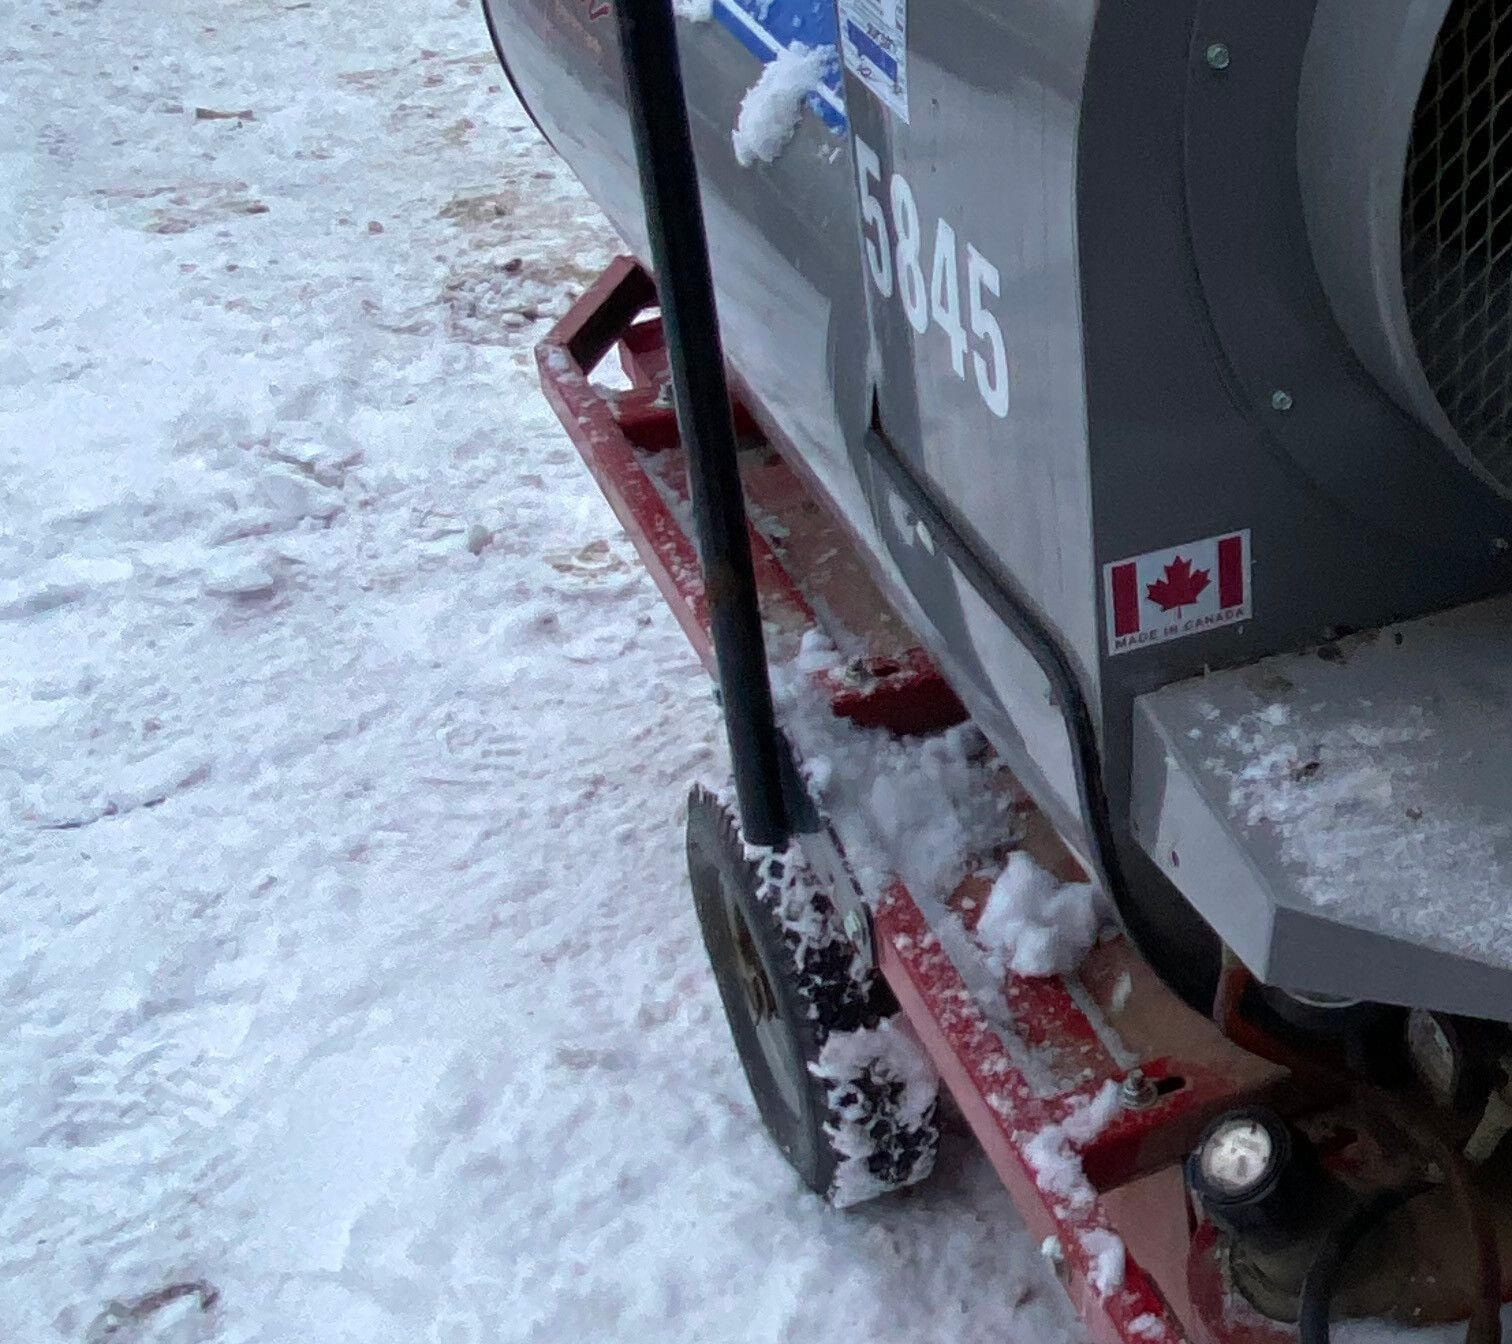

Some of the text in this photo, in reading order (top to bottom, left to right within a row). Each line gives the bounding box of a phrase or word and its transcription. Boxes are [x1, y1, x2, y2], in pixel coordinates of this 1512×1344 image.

[855, 133, 1010, 419] 5845
[1115, 607, 1245, 650] MADE IN CANADA
